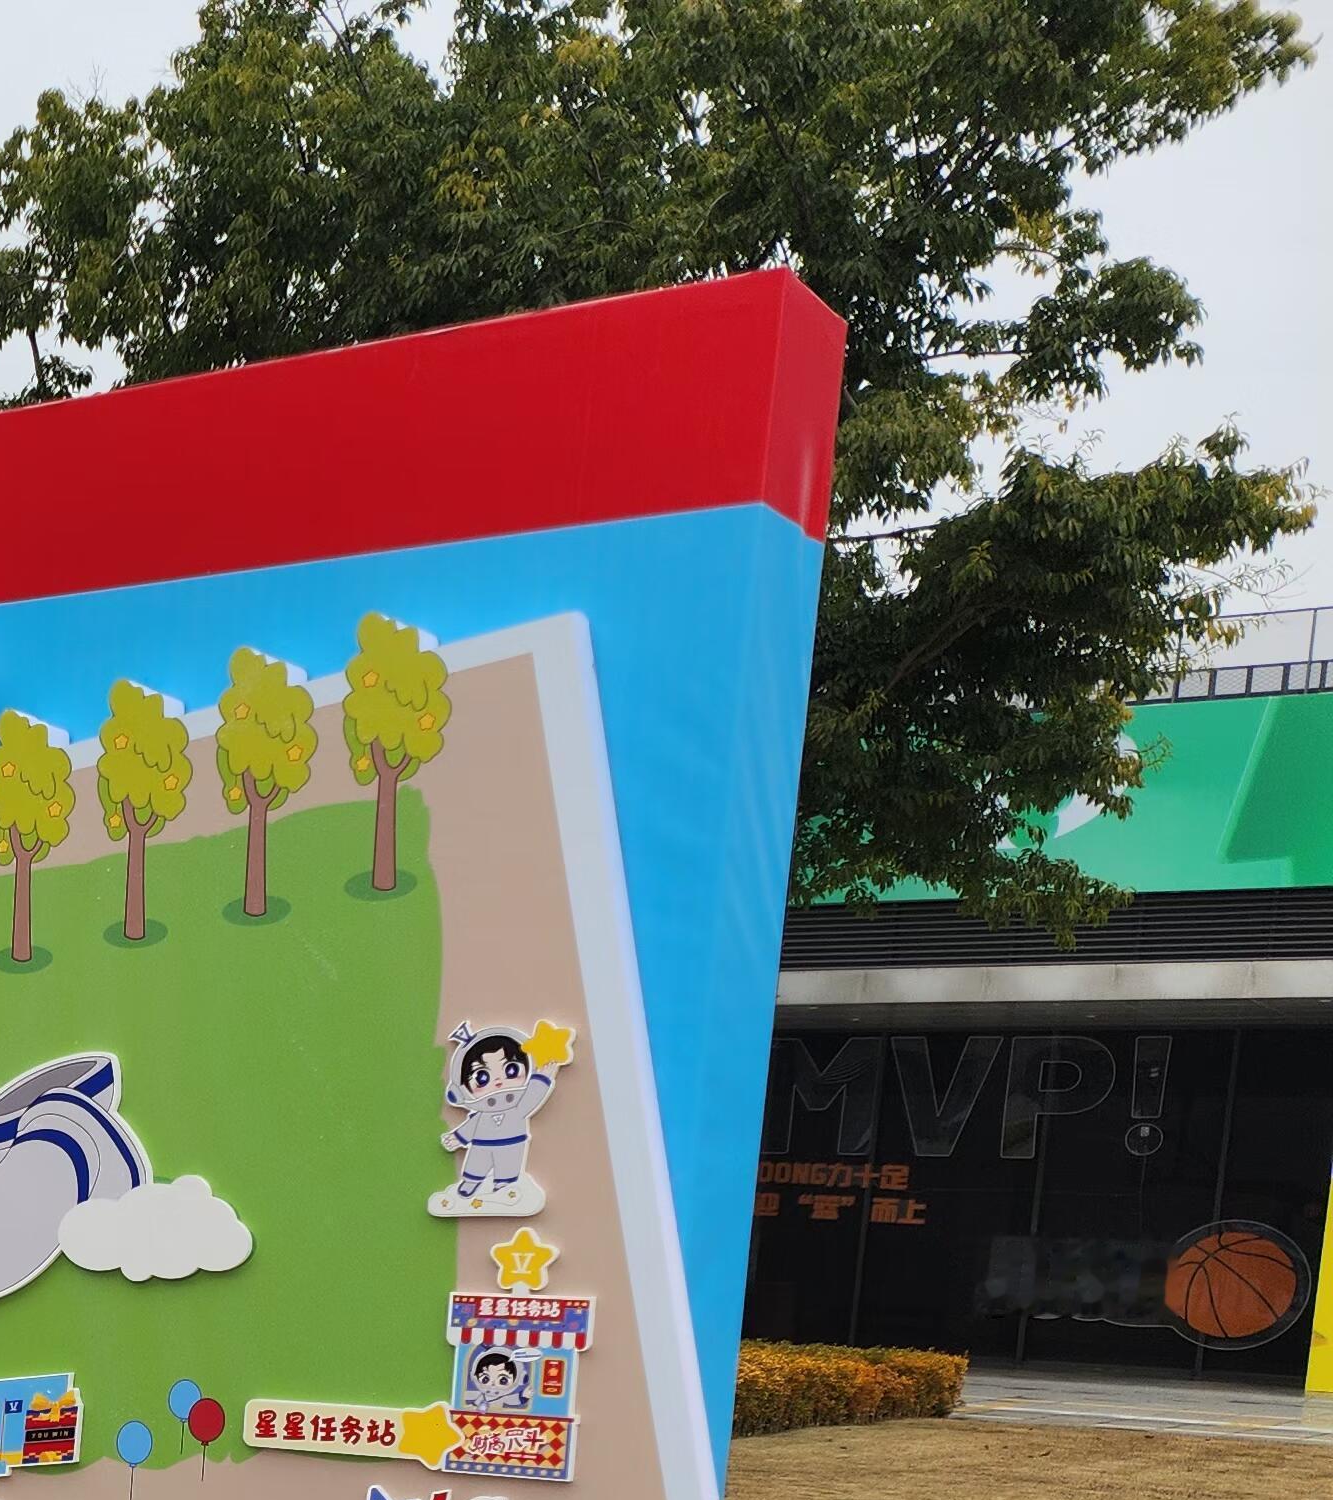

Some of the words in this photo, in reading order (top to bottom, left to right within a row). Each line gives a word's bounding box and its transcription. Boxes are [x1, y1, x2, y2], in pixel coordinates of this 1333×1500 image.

[479, 1298, 561, 1318] 星星任务站
[31, 1431, 49, 1439] YOU
[51, 1430, 69, 1438] WIN
[254, 1409, 397, 1447] 星星任务站
